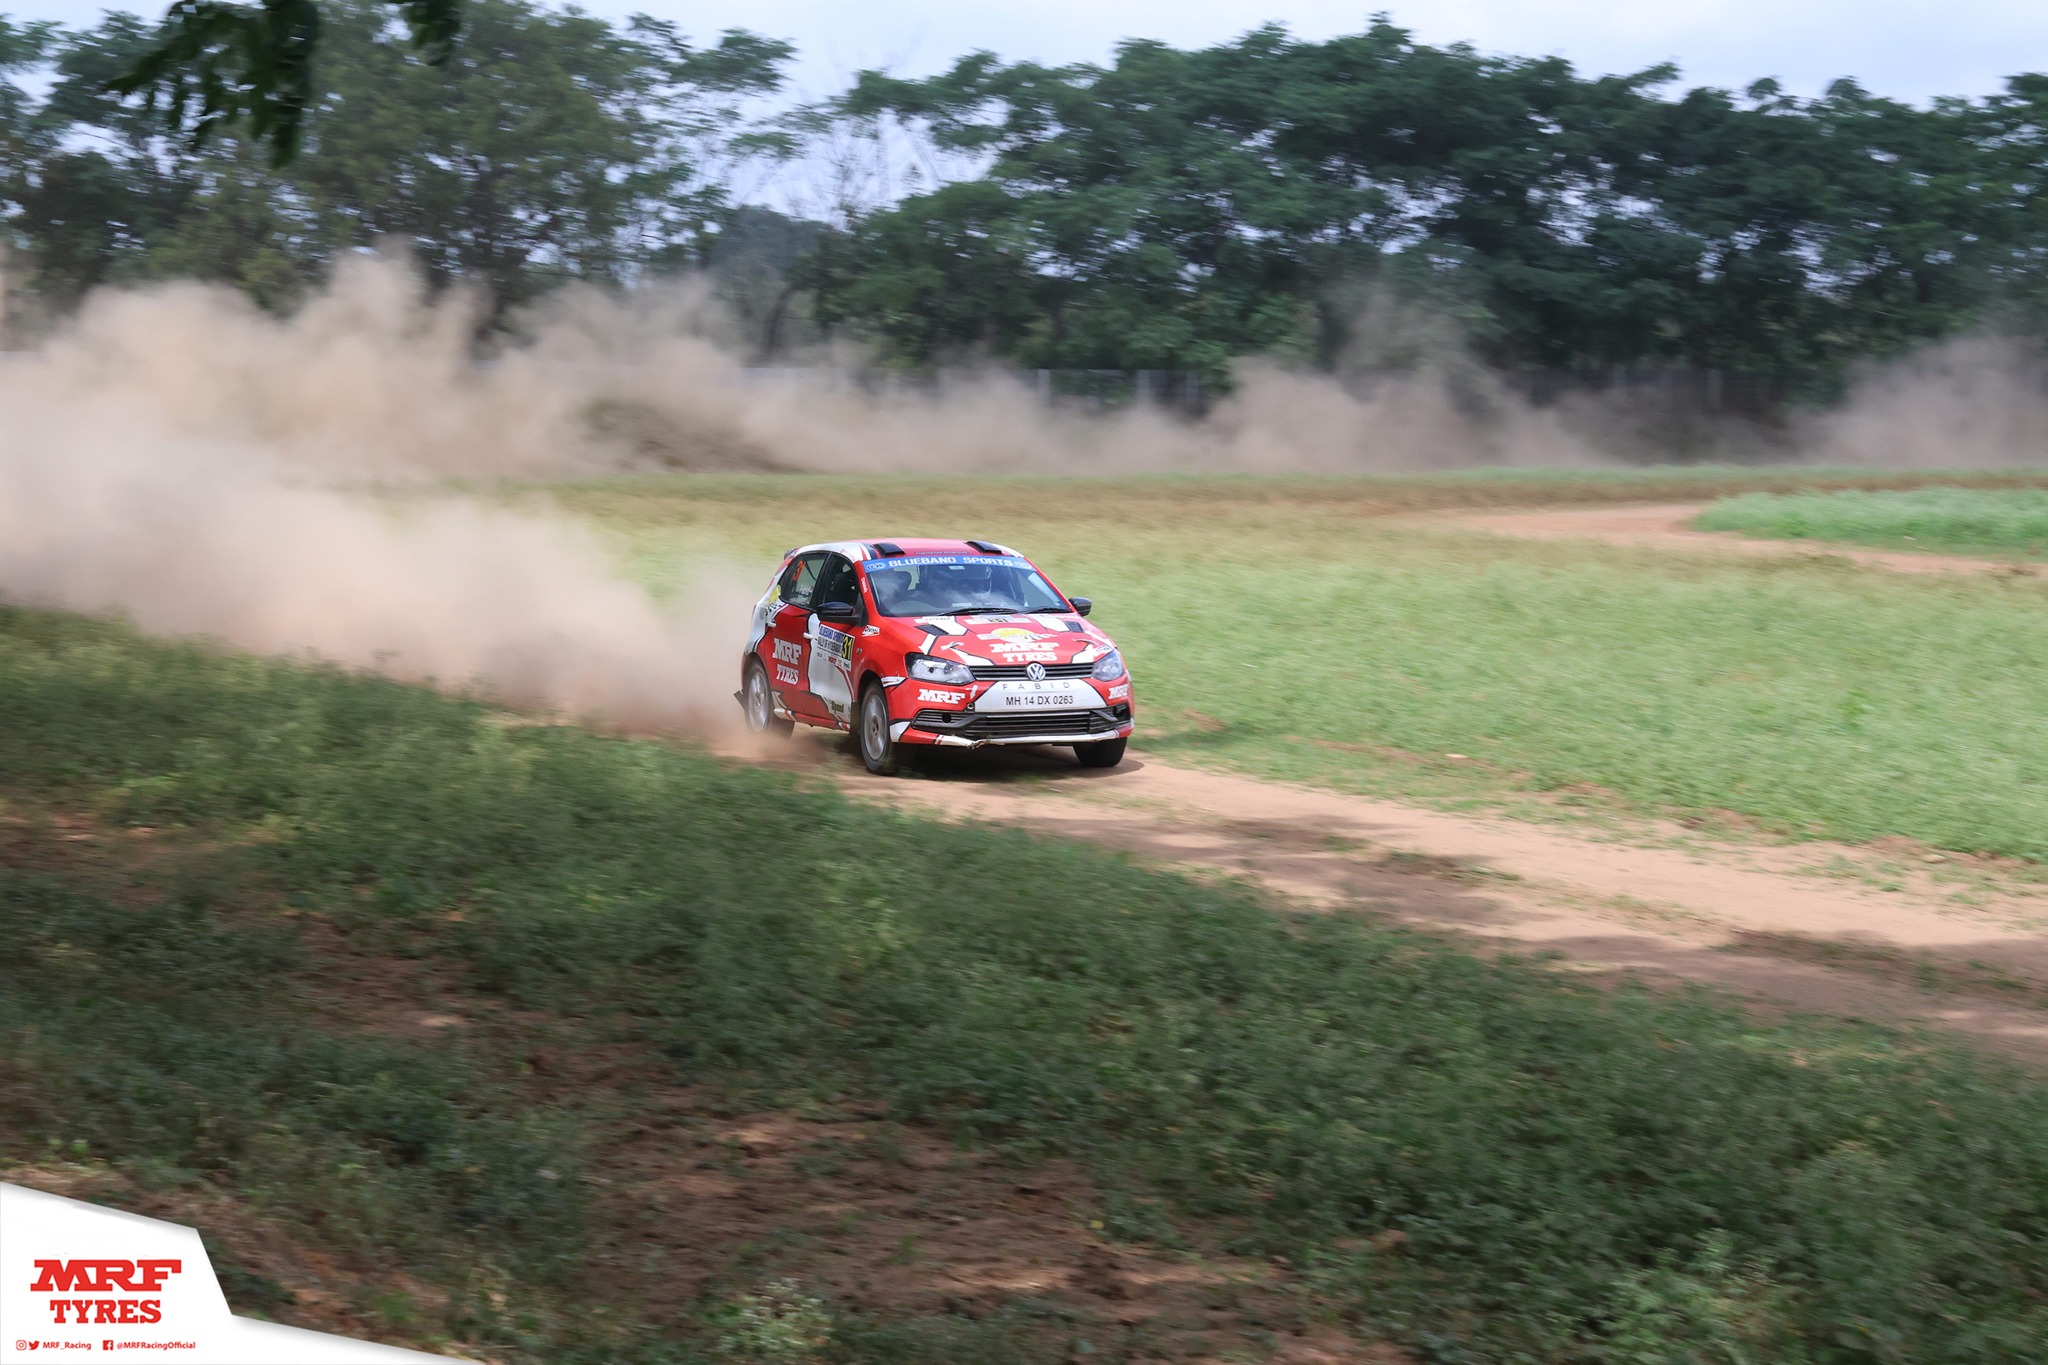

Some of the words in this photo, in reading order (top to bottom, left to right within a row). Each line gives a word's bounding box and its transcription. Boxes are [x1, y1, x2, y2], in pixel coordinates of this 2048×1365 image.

[888, 556, 957, 568] BLUEBAND
[962, 556, 1014, 567] SPORTS
[772, 638, 802, 666] MRF
[842, 636, 853, 660] 31
[988, 642, 1060, 654] MRF
[1002, 652, 1058, 662] TYRES
[776, 663, 800, 685] TYRES
[917, 688, 966, 704] MRF
[1108, 683, 1129, 699] MRF
[1005, 696, 1021, 706] MH
[1024, 696, 1035, 705] 14
[1037, 695, 1051, 705] DX
[1053, 695, 1074, 705] 0263
